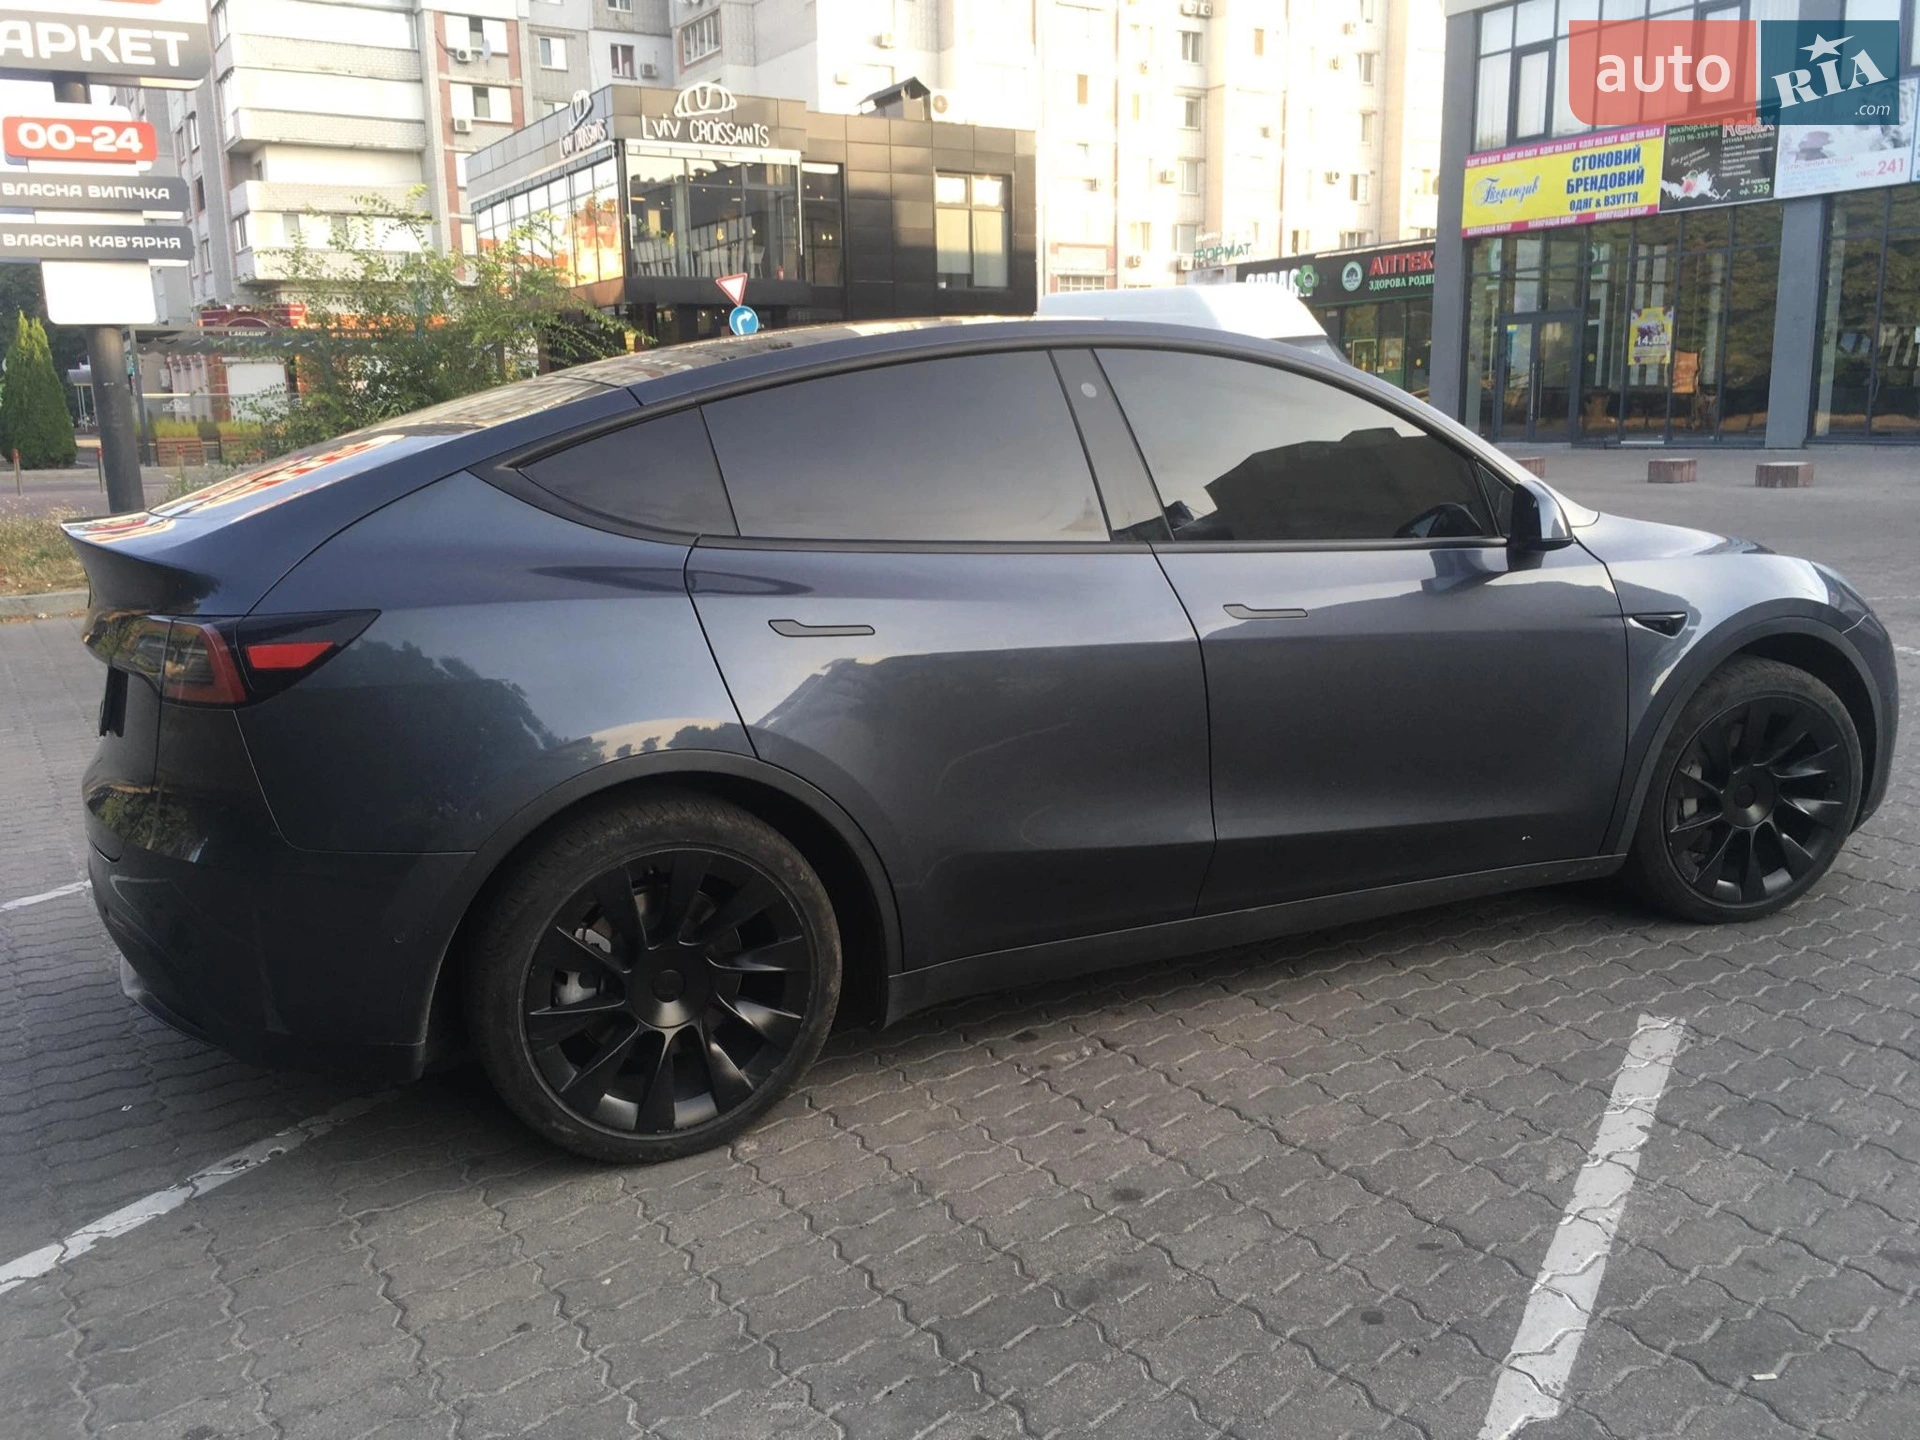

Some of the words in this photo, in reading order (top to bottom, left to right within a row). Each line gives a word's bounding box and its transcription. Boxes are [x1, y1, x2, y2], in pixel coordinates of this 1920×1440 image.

[17, 122, 143, 154] 00-24
[1572, 144, 1642, 173] СТОКОВИЙ
[1877, 158, 1905, 176] 241
[1566, 166, 1645, 195] БРЕНДОВИЙ
[1753, 183, 1770, 195] 229
[2, 181, 82, 198] ВЛАСНА
[87, 184, 170, 201] ВИПІЧКА
[1569, 196, 1593, 212] ОДЯГ
[1603, 191, 1639, 207] ВЗУТТЯ
[3, 233, 83, 248] ВЛАСНА
[89, 235, 182, 250] КАВ'ЯРНЯ
[1194, 242, 1252, 262] ФОРМАТ
[1369, 249, 1435, 276] АПТЕК
[1368, 277, 1406, 292] ЗДОРОВА
